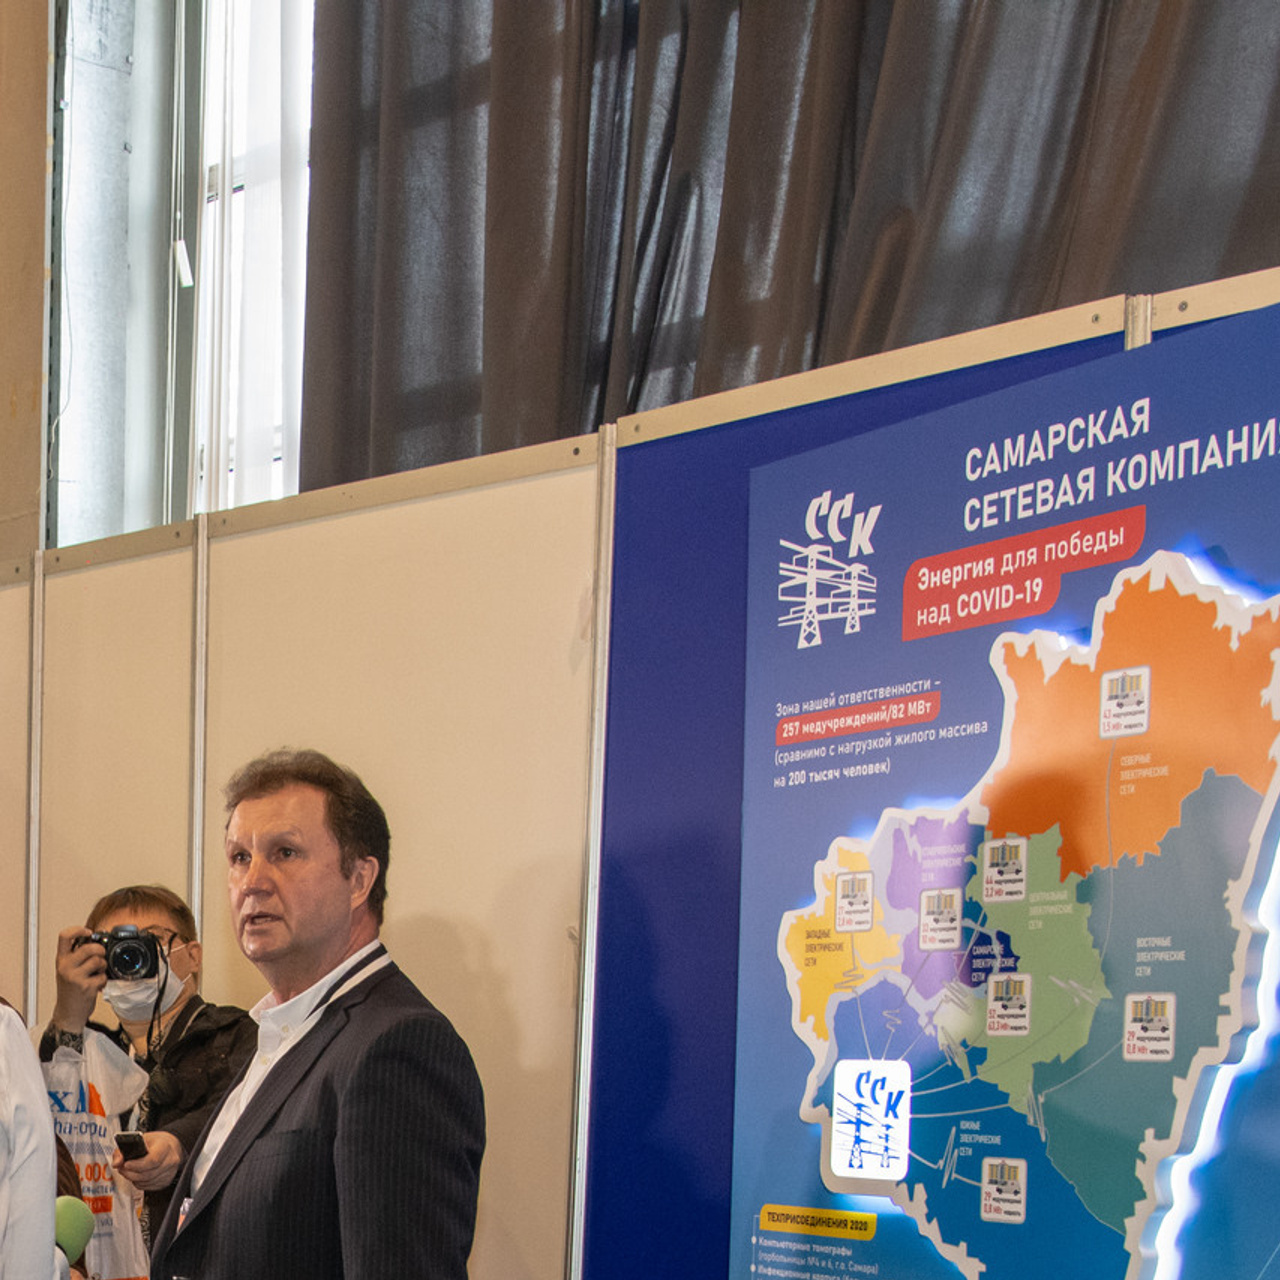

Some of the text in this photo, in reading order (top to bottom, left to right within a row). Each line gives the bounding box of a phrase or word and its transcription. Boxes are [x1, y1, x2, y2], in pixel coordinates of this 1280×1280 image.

[965, 397, 1151, 482] САМАРСКАЯ
[964, 417, 1280, 532] СЕТЕВАЯ КОМПАНИ
[805, 490, 883, 558] ССК
[917, 527, 1125, 592] Энергия для победы
[917, 577, 1043, 627] над COVID-19
[776, 702, 800, 717] Зона
[802, 693, 836, 713] нашей
[838, 678, 931, 707] ответственности
[782, 701, 932, 738] 257 медучреждений/82 МВт
[774, 721, 988, 766] (сравнимо с нагрузкой жилого массива
[774, 757, 891, 788] на 200 тысяч человек)
[855, 1070, 905, 1119] ССК
[767, 1211, 868, 1231] ТЕХПРИСОЕДИНЕНИЯ 2020
